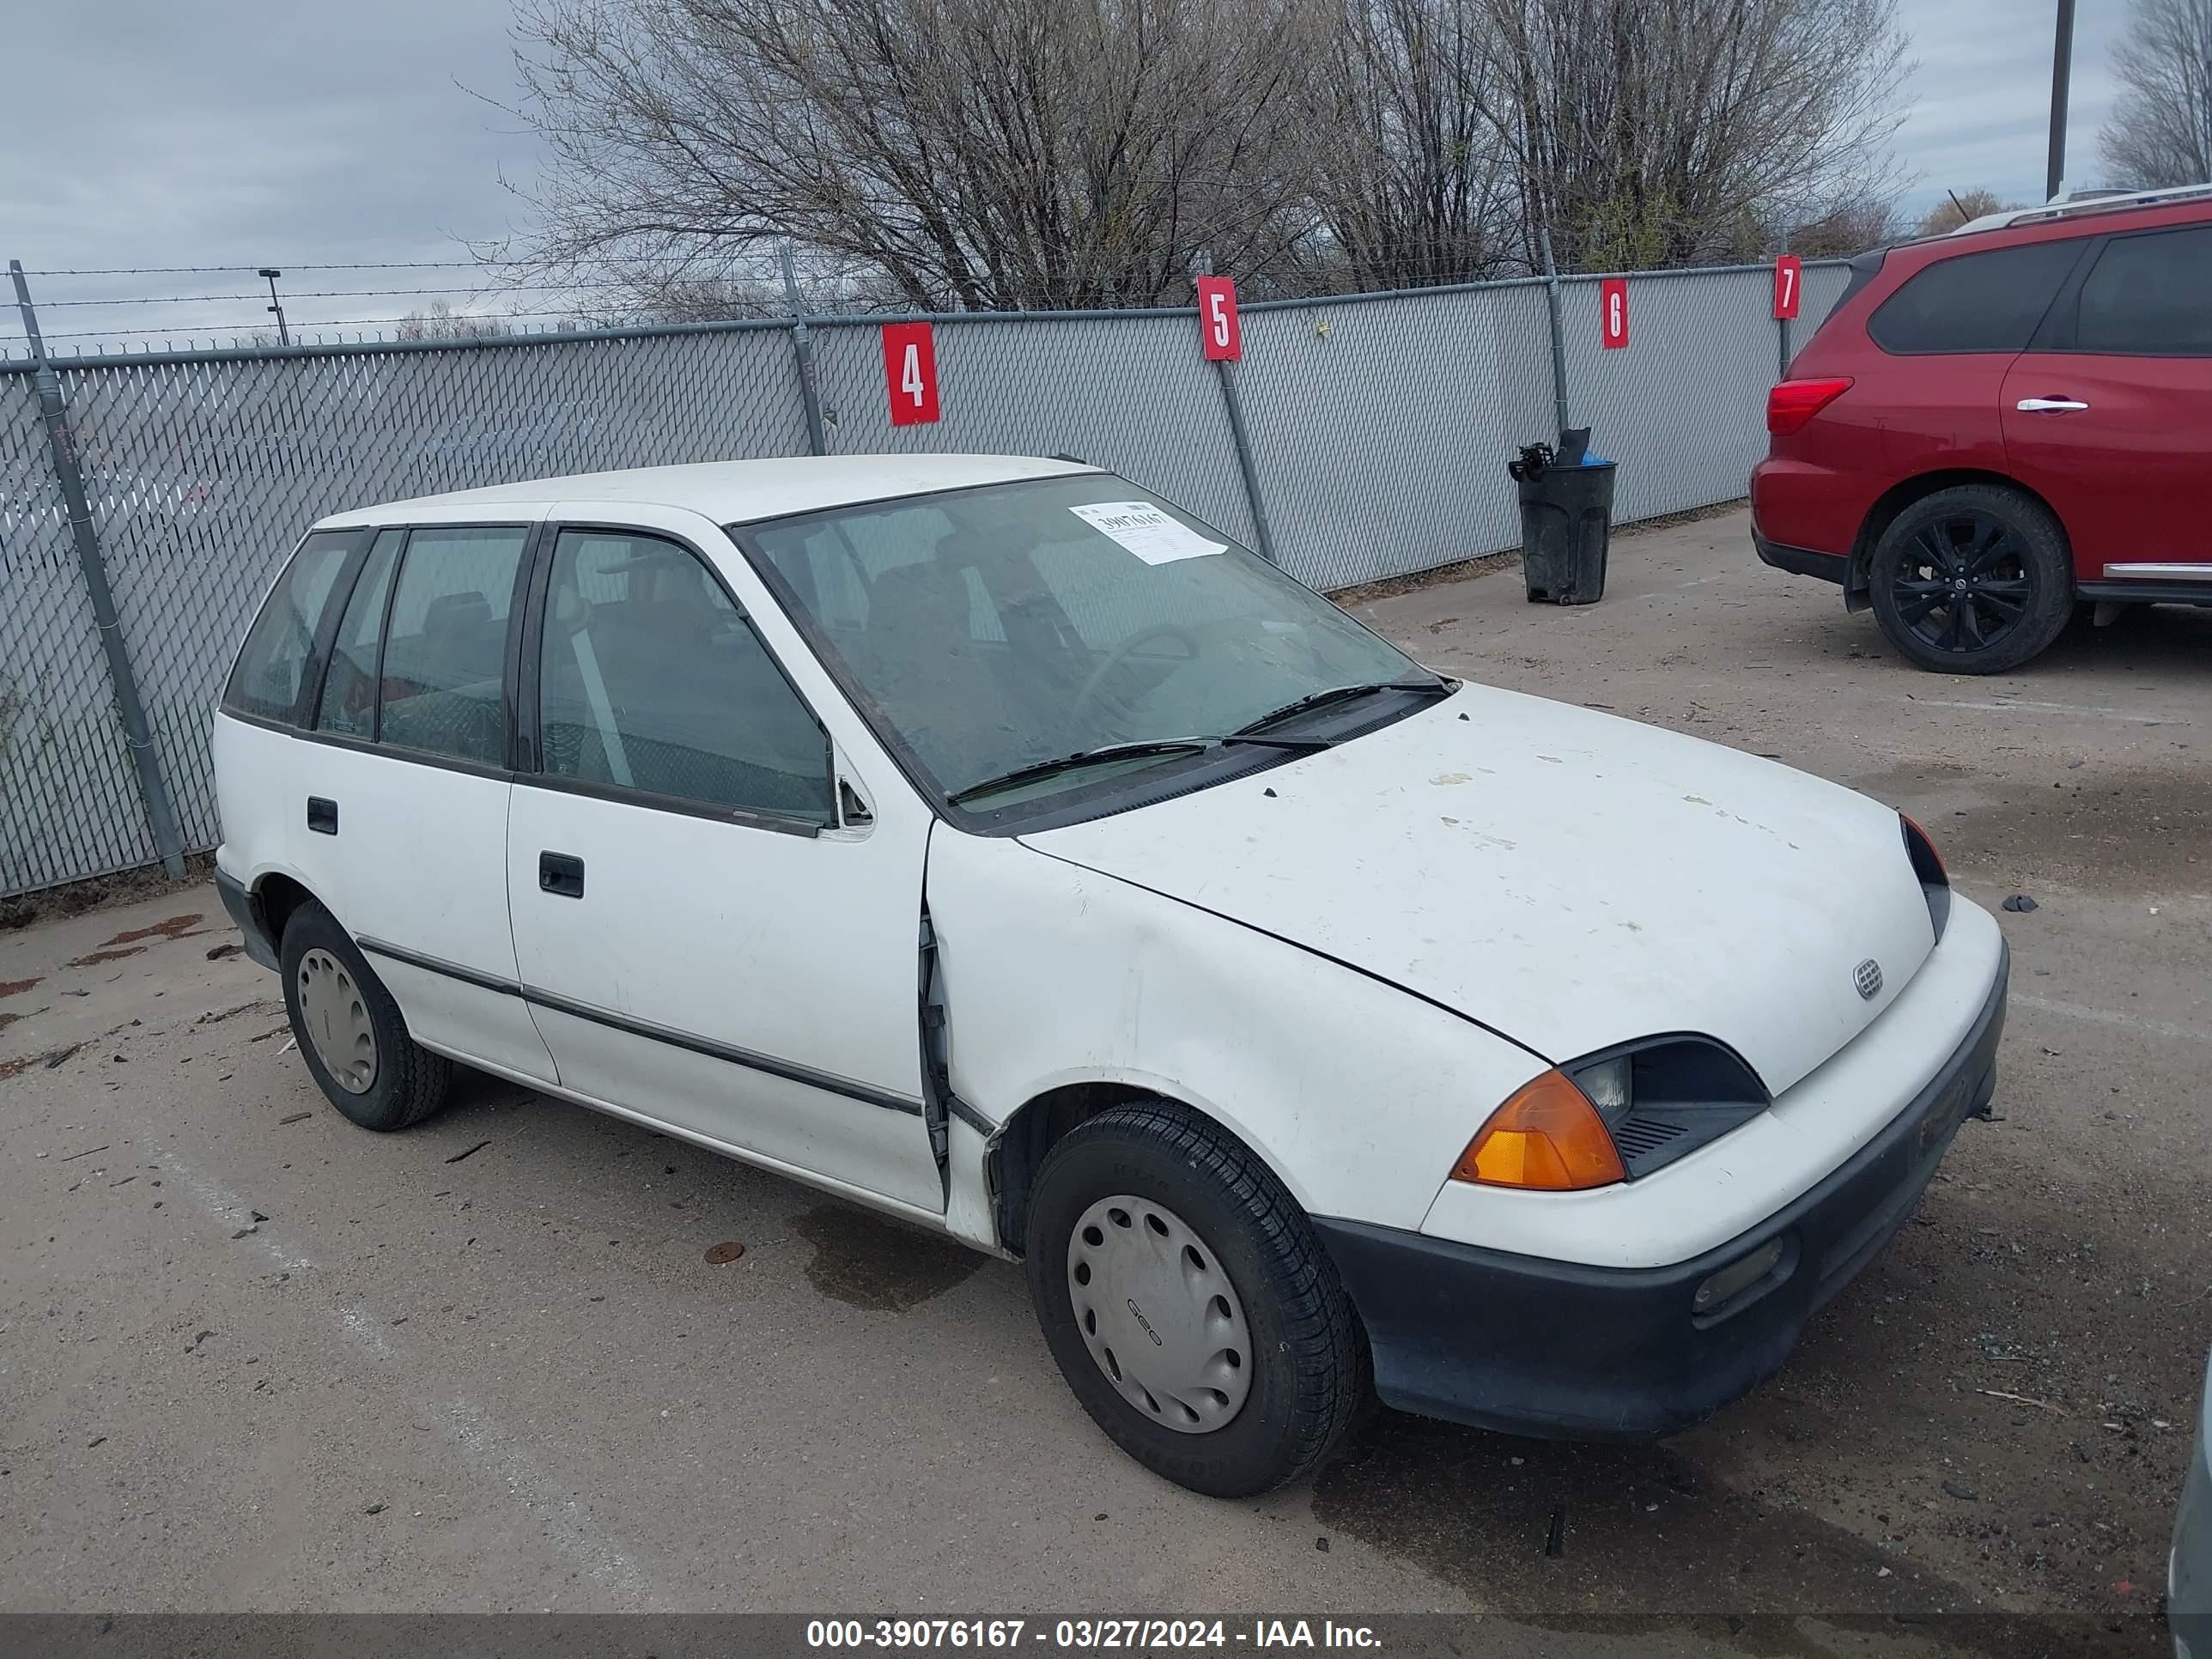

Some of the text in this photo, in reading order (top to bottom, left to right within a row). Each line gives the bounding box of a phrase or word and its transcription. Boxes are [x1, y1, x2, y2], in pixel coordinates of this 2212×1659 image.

[1783, 269, 1794, 308] 7
[1210, 294, 1230, 347] 5
[1610, 293, 1621, 337] 6
[902, 344, 924, 407] 4
[1097, 514, 1168, 530] 39076167
